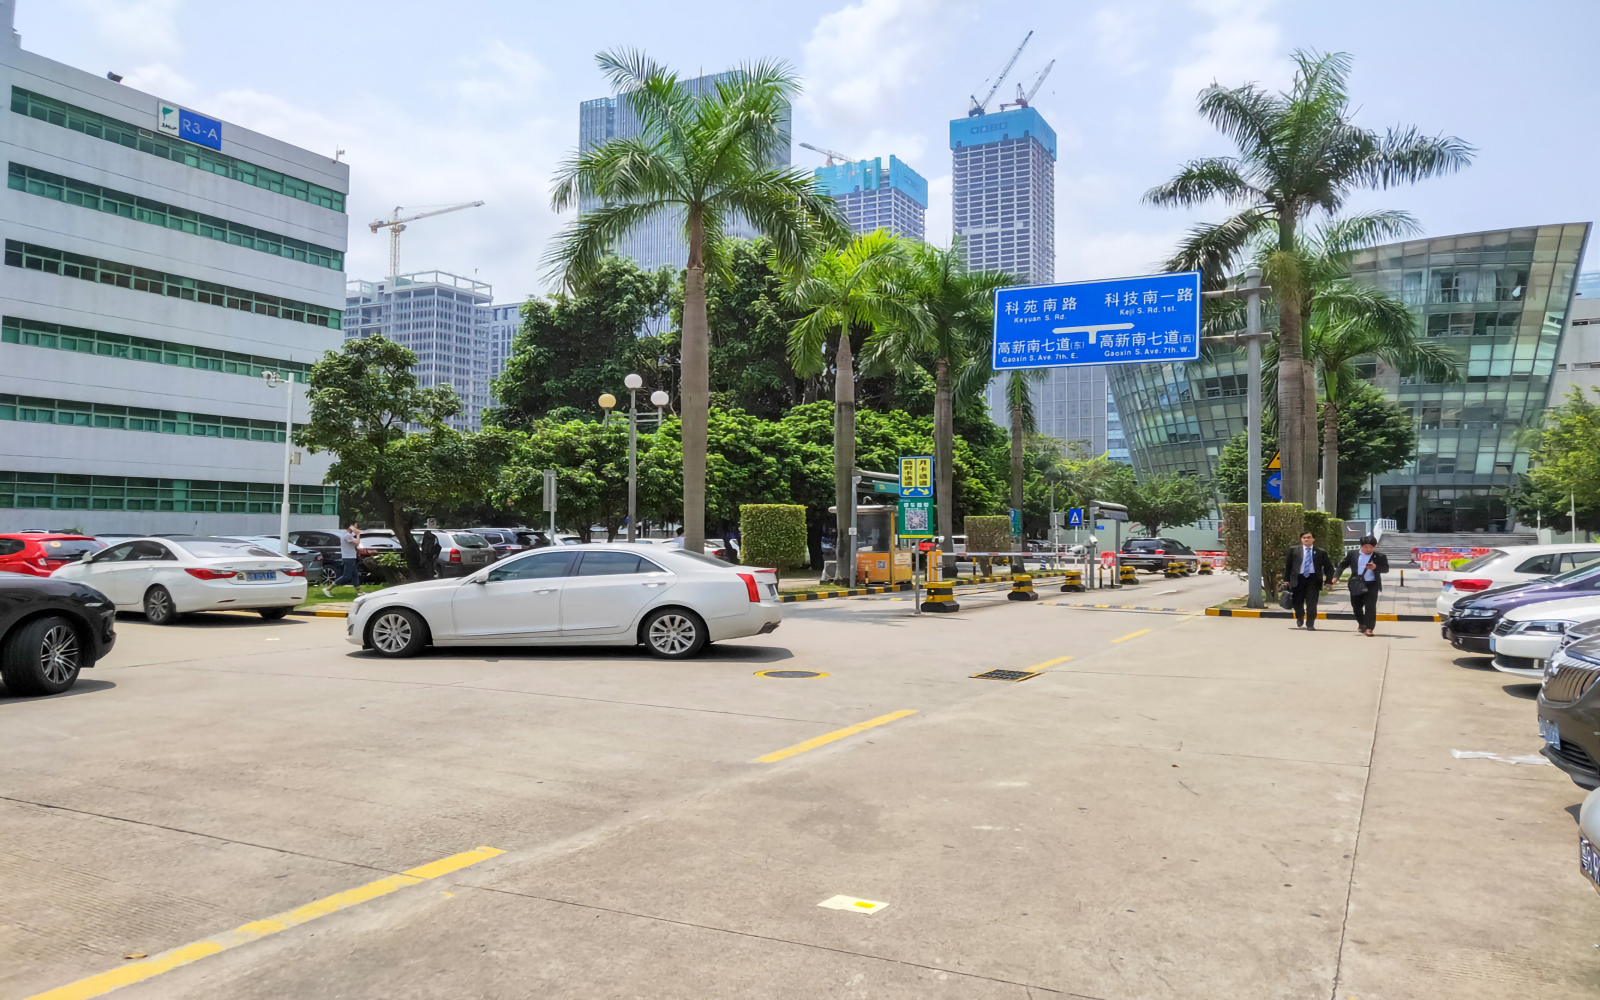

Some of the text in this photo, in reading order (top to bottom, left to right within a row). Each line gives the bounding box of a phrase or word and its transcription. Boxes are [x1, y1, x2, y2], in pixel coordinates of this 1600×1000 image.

[182, 119, 218, 140] R3-A
[1104, 287, 1194, 307] 科技南一路
[1005, 297, 1077, 315] 科苑南路
[1119, 308, 1135, 316] Keji
[1013, 315, 1042, 324] Keyuan
[1002, 354, 1027, 363] Gaoxin
[1055, 352, 1069, 360] 7th.
[1104, 349, 1132, 357] Gaoxin
